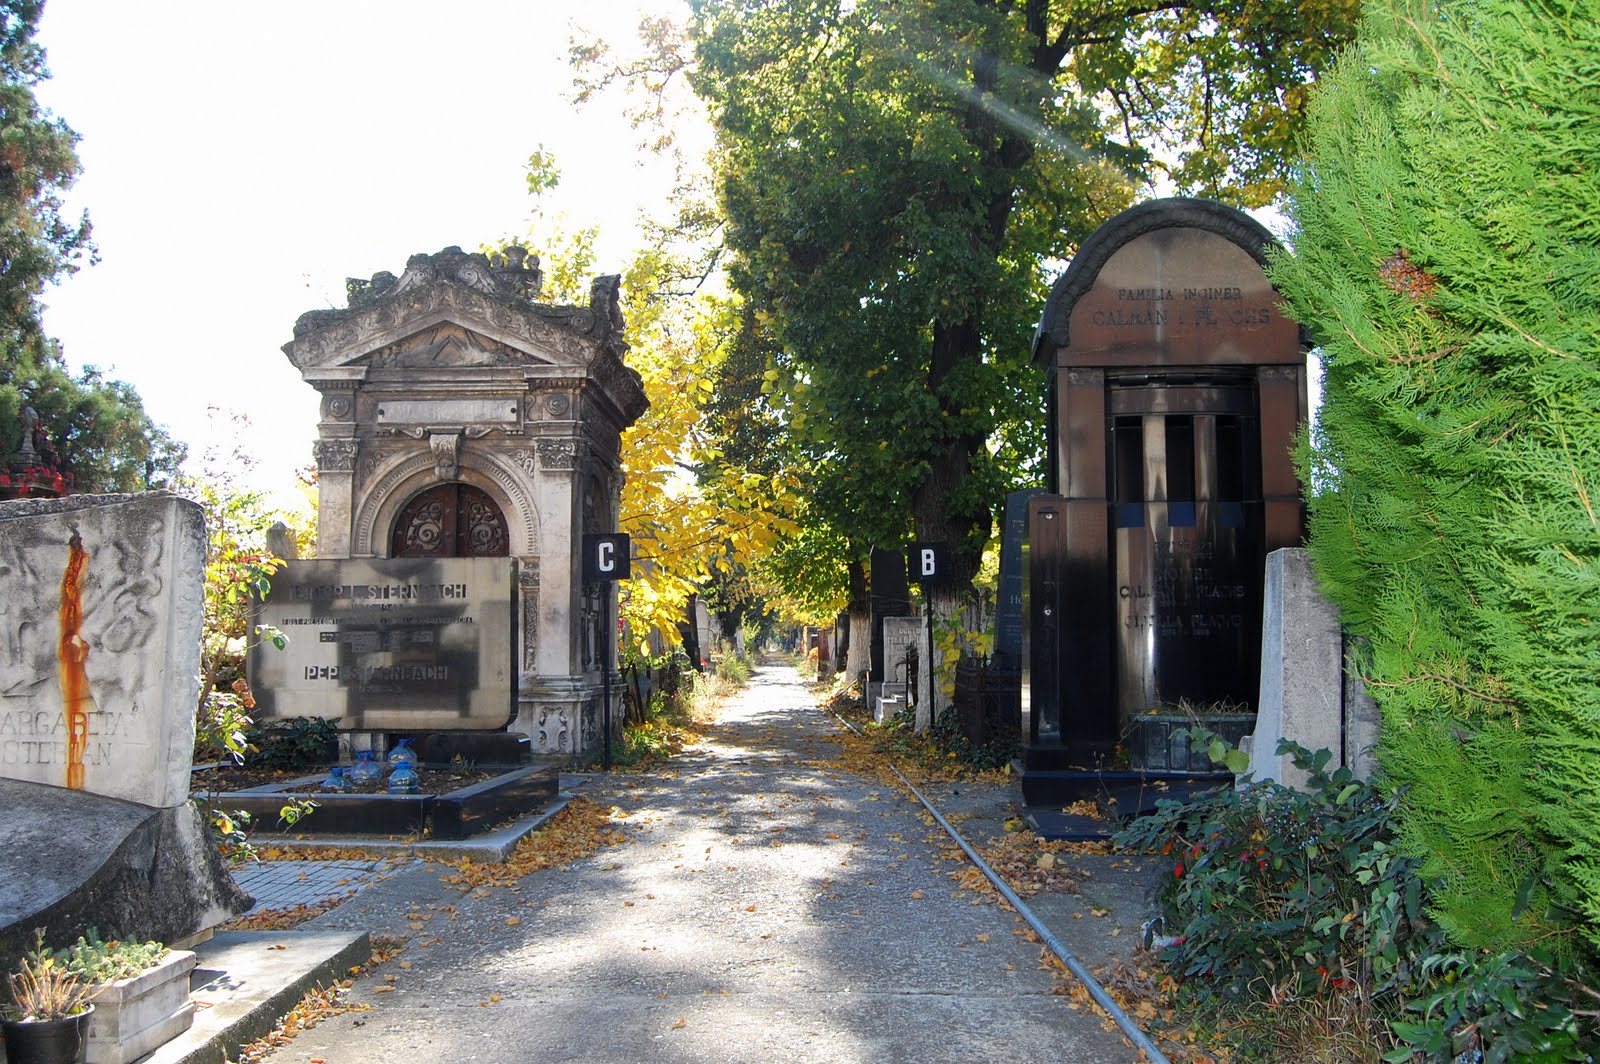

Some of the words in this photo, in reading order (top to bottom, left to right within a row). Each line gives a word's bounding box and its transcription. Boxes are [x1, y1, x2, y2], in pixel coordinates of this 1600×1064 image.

[1118, 287, 1174, 301] FAMILIA
[608, 542, 625, 573] C
[921, 548, 936, 577] B
[0, 711, 129, 737] ARGARETA
